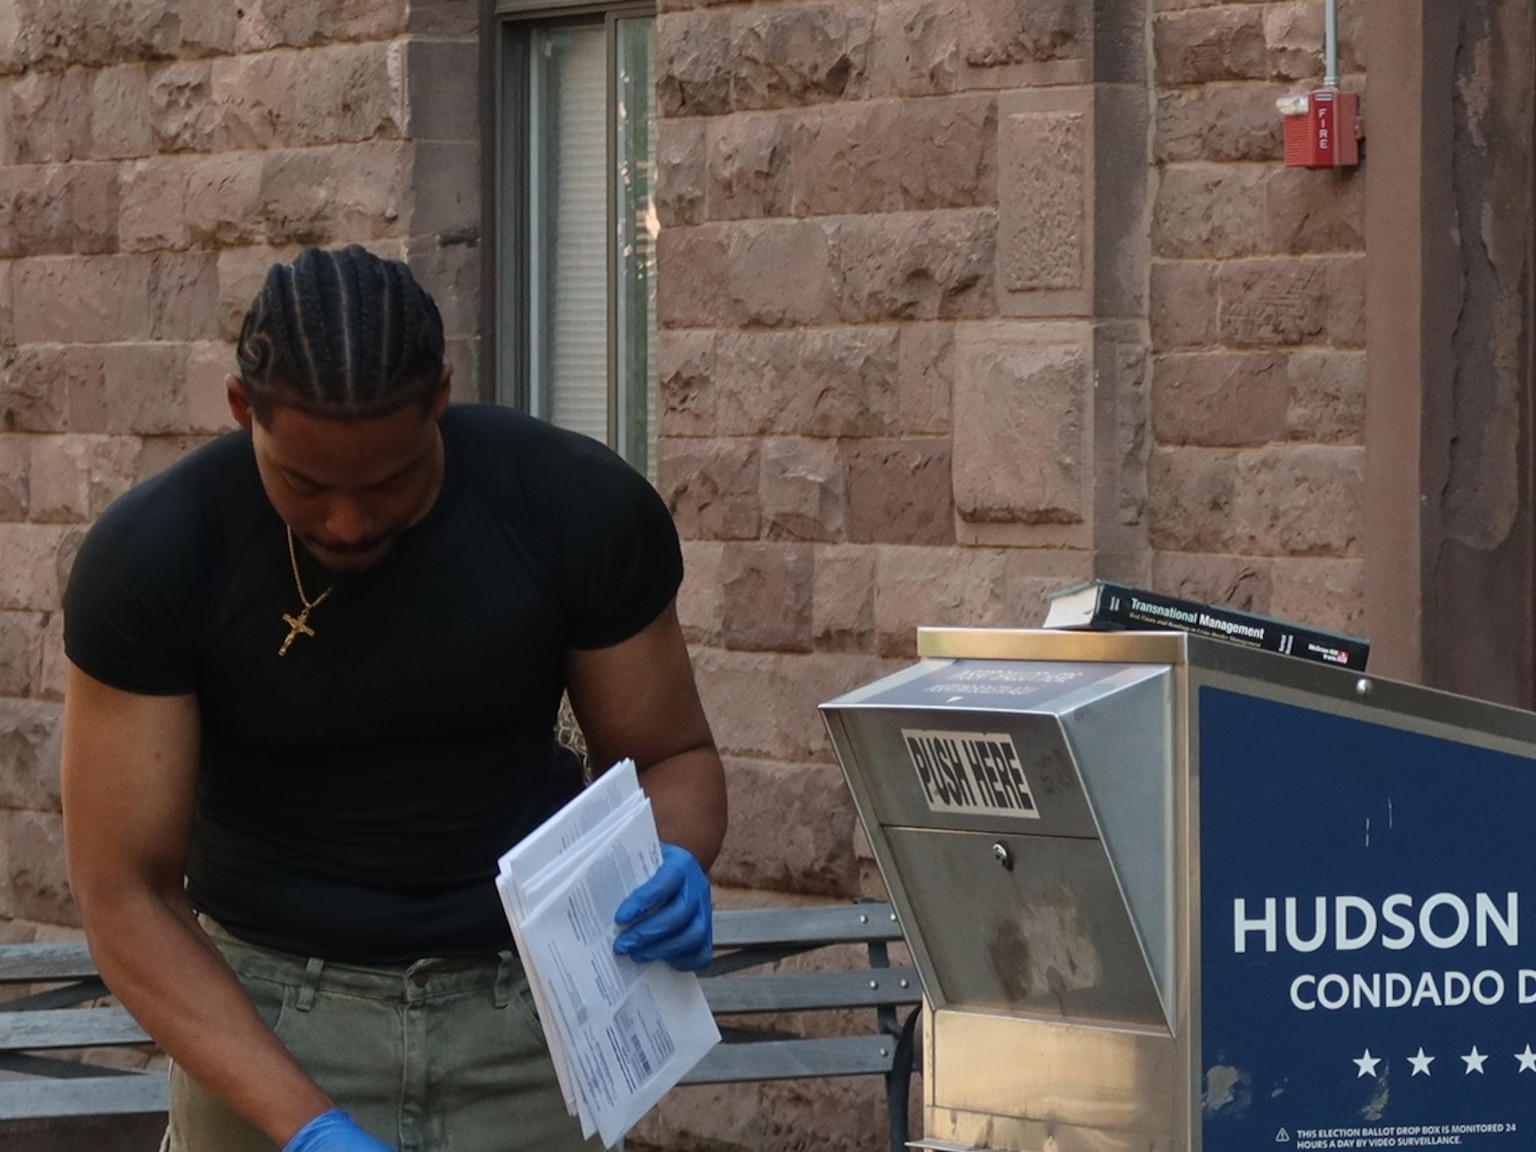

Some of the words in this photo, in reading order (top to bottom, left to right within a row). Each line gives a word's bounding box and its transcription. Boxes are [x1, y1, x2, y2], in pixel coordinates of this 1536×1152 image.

[1318, 108, 1329, 149] FIRE
[1131, 597, 1198, 625] Transnational
[1198, 613, 1265, 640] Management
[906, 736, 978, 807] PUSH
[961, 739, 1035, 811] HERE
[1234, 892, 1518, 952] HUDSON
[1291, 970, 1504, 1010] CONDADO
